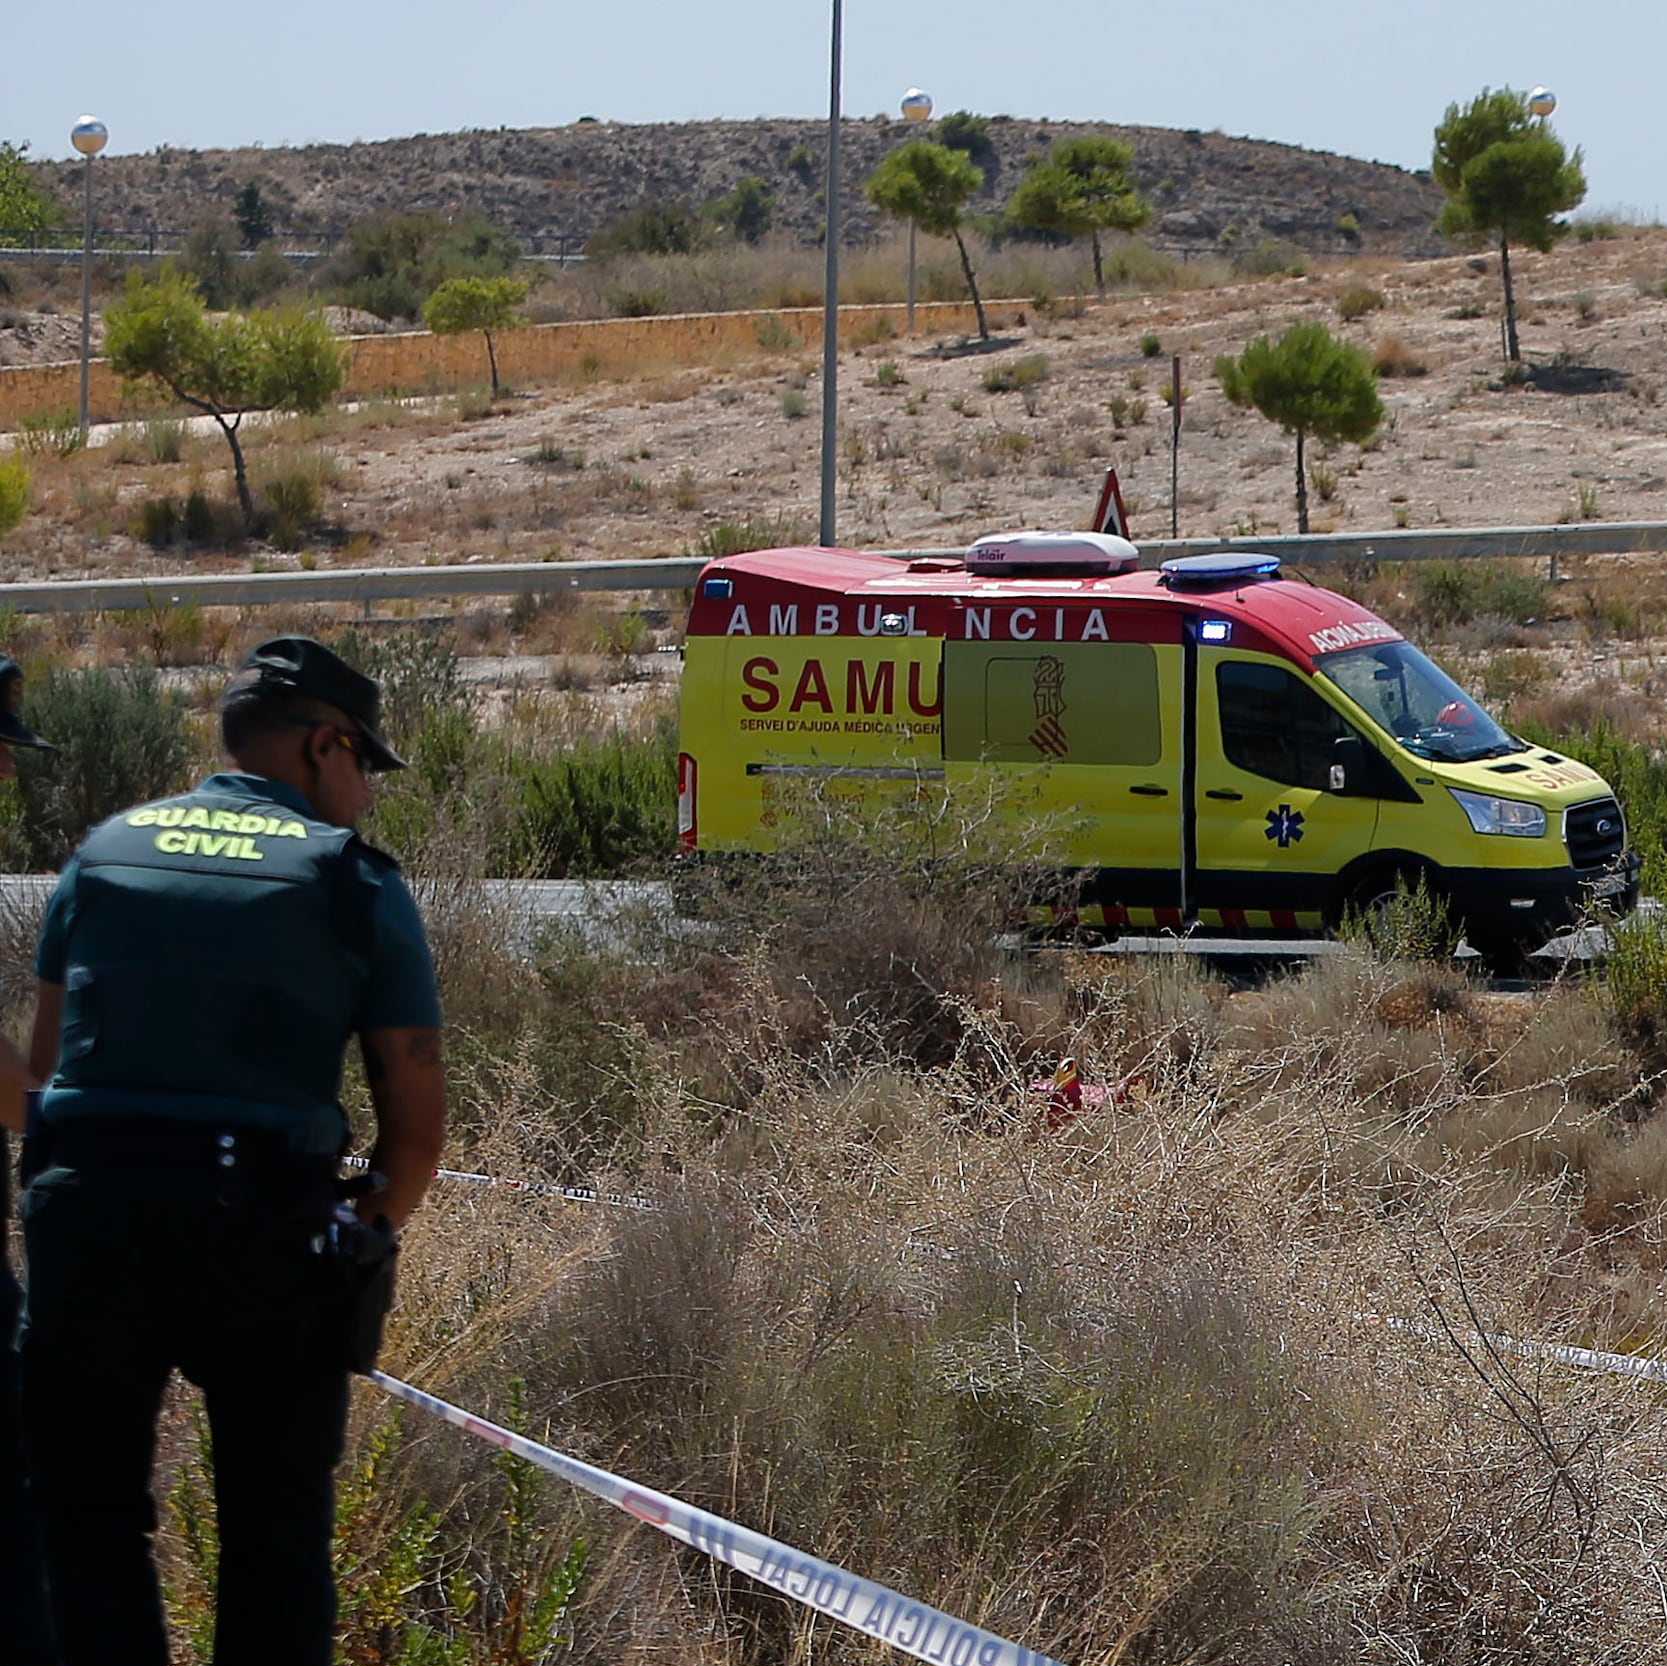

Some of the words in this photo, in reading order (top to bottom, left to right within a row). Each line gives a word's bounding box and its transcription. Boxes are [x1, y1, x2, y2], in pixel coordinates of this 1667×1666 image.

[977, 548, 1006, 561] Telair
[726, 600, 1109, 641] AMBULNCIA
[741, 656, 942, 717] SAMU
[740, 718, 784, 732] SERVEI
[786, 718, 841, 733] D'AJUDA
[896, 721, 942, 736] URGEN
[127, 807, 308, 839] GUARDIA
[154, 830, 264, 860] CIVIL
